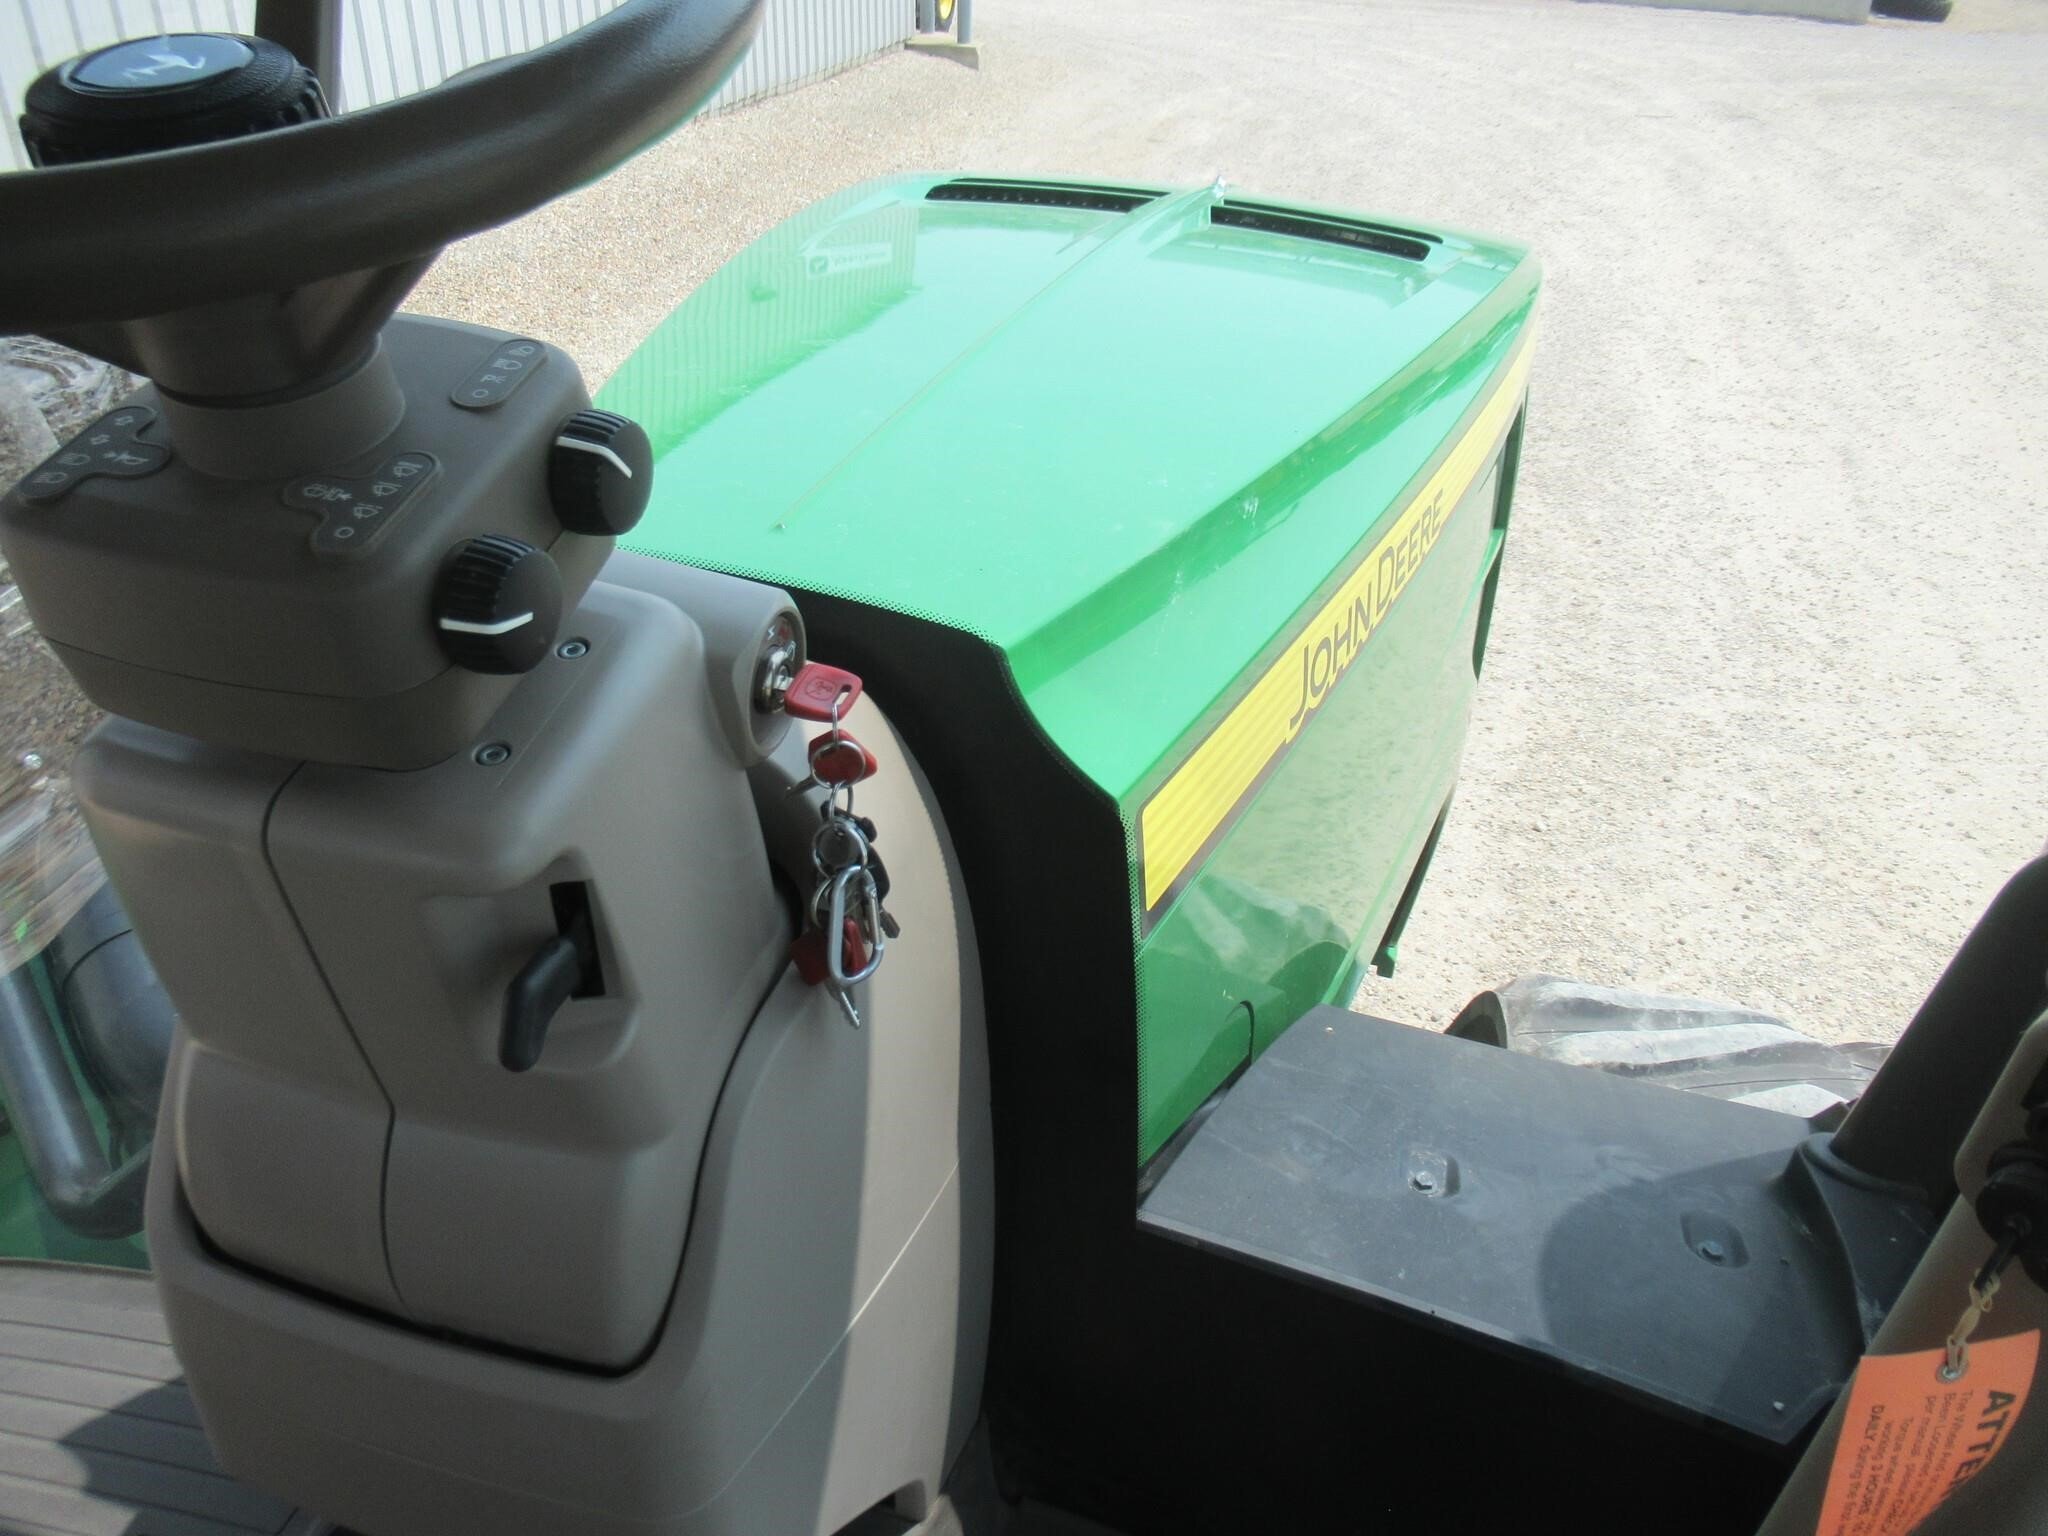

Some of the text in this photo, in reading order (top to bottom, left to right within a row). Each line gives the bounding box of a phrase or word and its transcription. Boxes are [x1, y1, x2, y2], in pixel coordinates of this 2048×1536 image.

[1289, 487, 1443, 731] JOHN DEERE
[1863, 1403, 1885, 1441] DAILY
